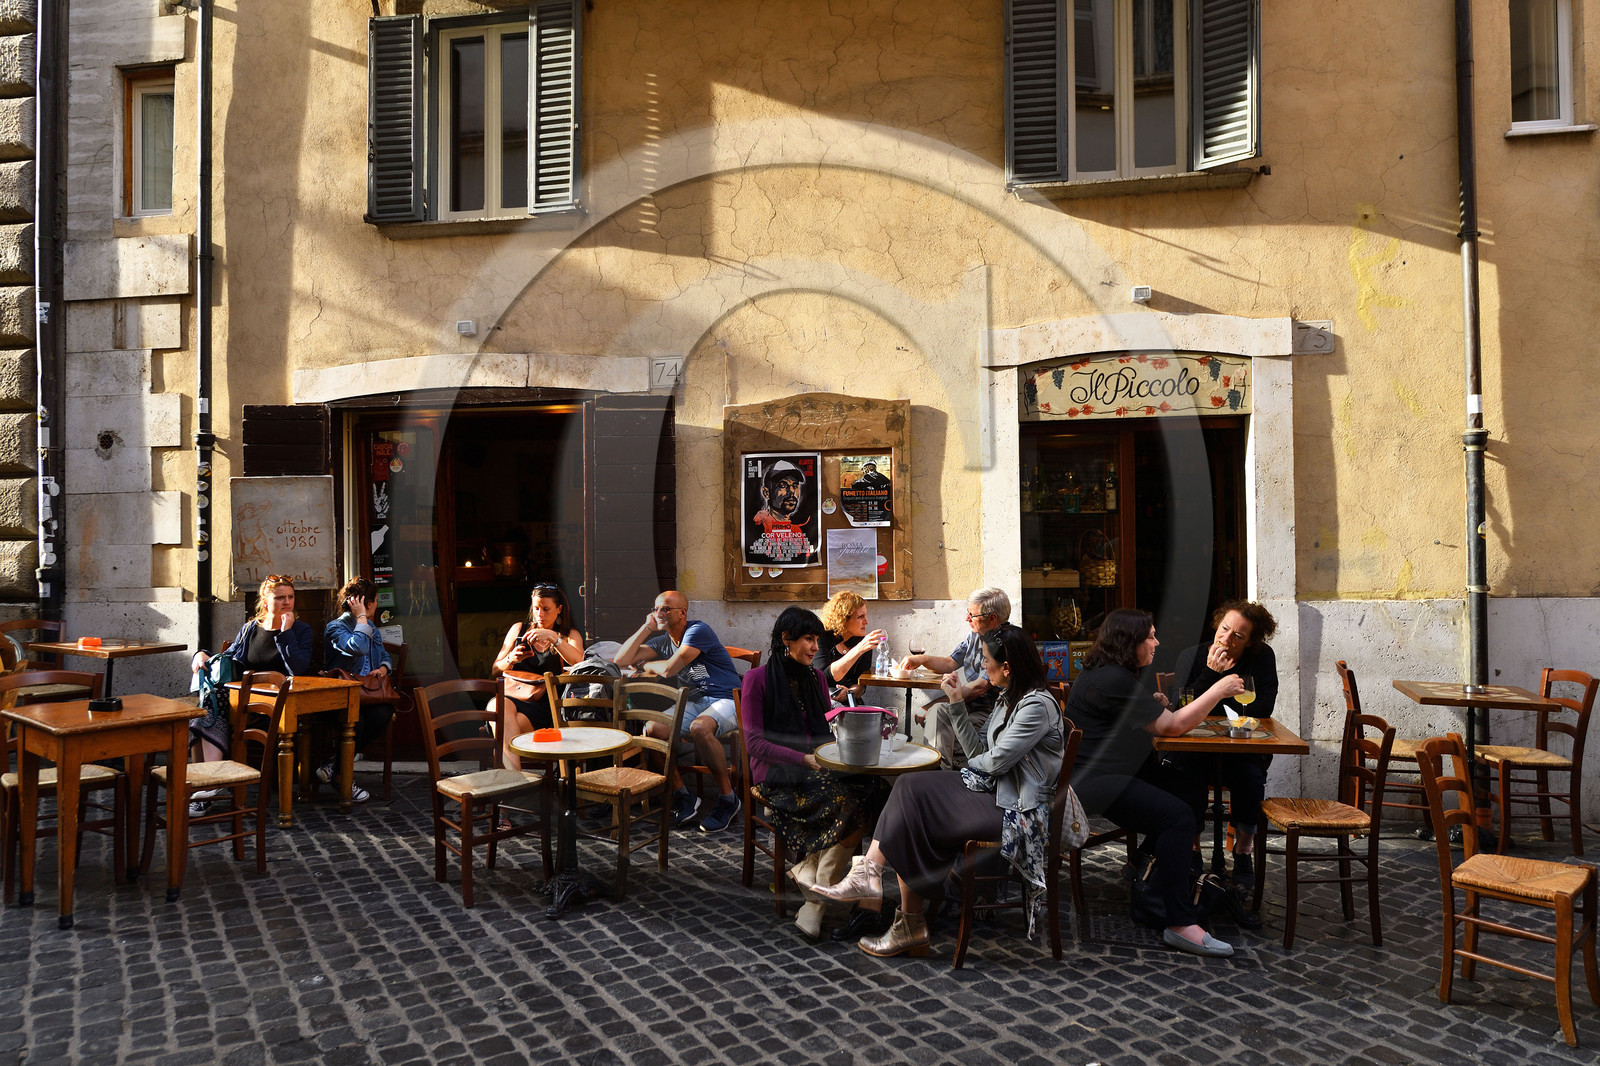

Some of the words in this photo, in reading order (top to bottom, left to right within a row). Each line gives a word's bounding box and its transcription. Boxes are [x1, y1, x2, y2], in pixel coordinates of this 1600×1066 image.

[1297, 326, 1328, 350] 75
[655, 362, 682, 383] 74
[1069, 368, 1107, 404] Il
[1100, 366, 1200, 405] Piccolo
[285, 535, 317, 551] 1980
[775, 531, 802, 539] VELENO
